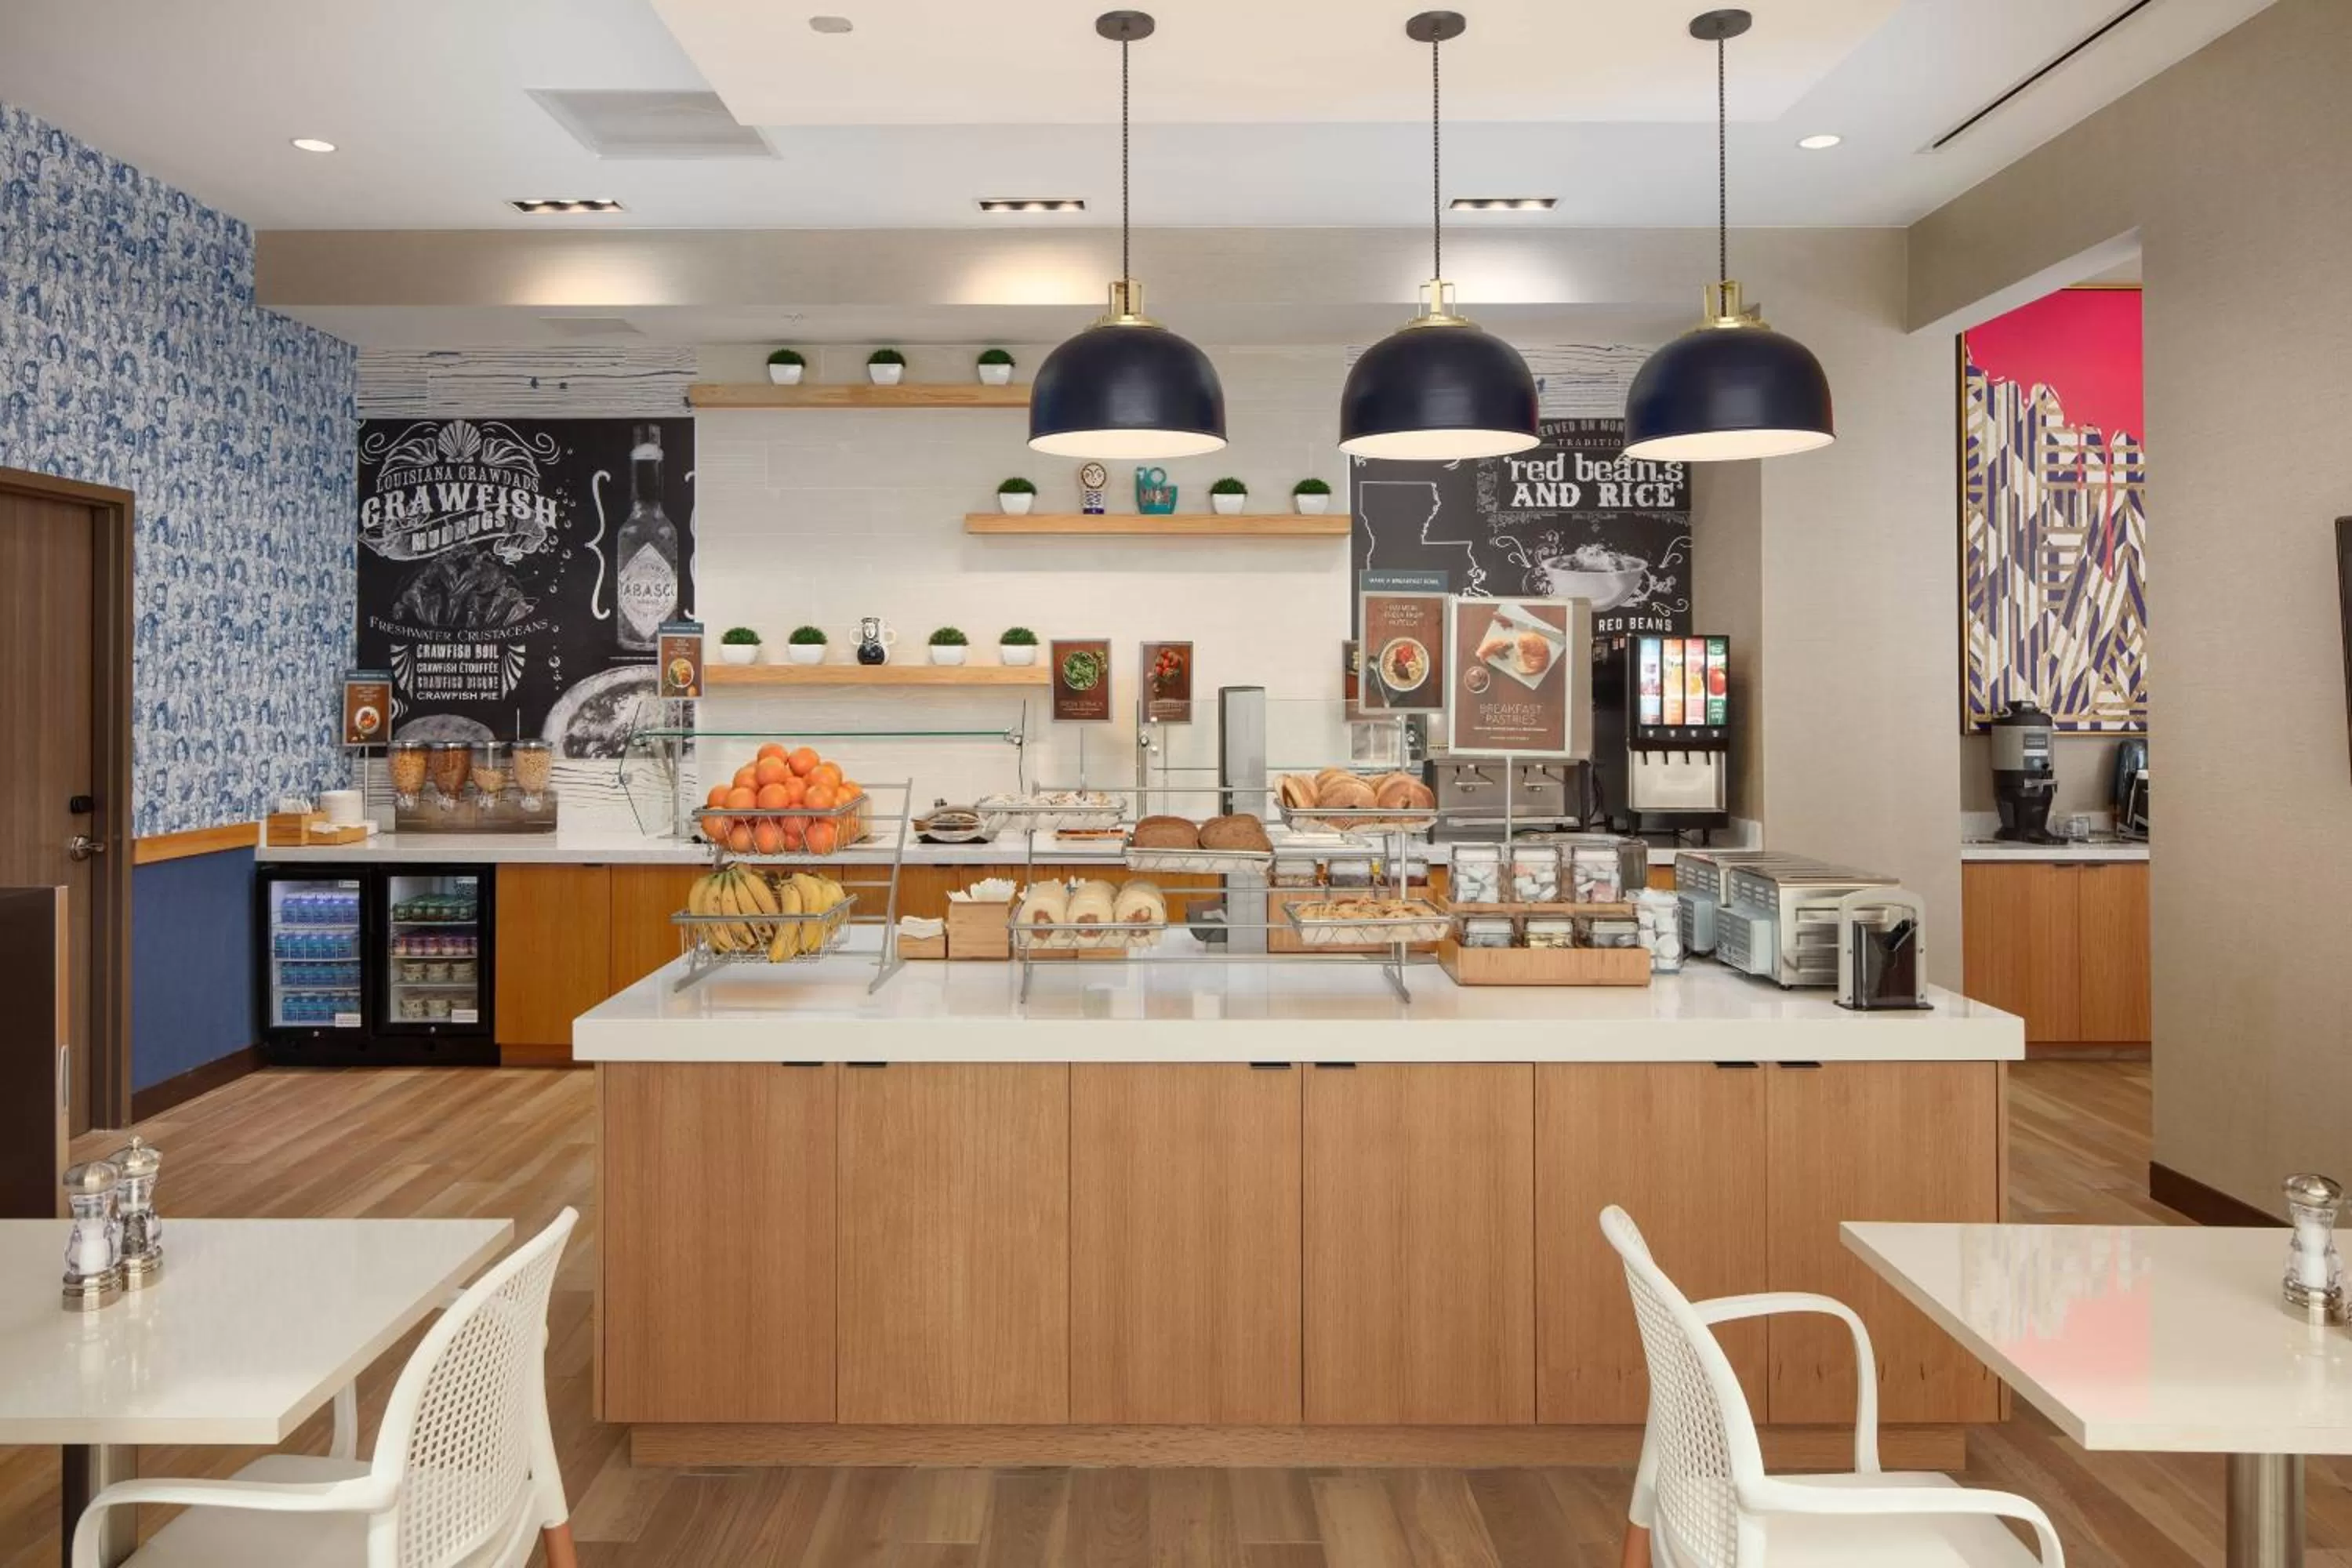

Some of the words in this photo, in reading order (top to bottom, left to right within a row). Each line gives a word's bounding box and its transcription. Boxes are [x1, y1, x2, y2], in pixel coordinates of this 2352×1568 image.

[1539, 419, 1575, 437] ERVED
[1580, 419, 1595, 431] ON
[1600, 419, 1625, 434] MON
[1557, 437, 1622, 447] TRADITIO
[1574, 452, 1685, 482] beans
[376, 466, 453, 493] LOUISIANA
[459, 465, 539, 493] CRAWDADS
[1509, 482, 1581, 507] AND
[361, 482, 557, 530] CRAWFISH
[370, 616, 452, 641] FRESHWATER
[458, 619, 549, 641] CRUSTACEANS
[1599, 619, 1623, 631] RED
[1629, 618, 1672, 631] BEANS
[416, 644, 471, 659] CRAWFISH
[475, 644, 499, 659] BOIL
[416, 662, 457, 673] CRAWFISH
[416, 691, 477, 700] CRAWFISH
[480, 691, 499, 700] PIE
[1479, 702, 1544, 715] BREAKFAST
[1486, 713, 1537, 725] PASTRIES
